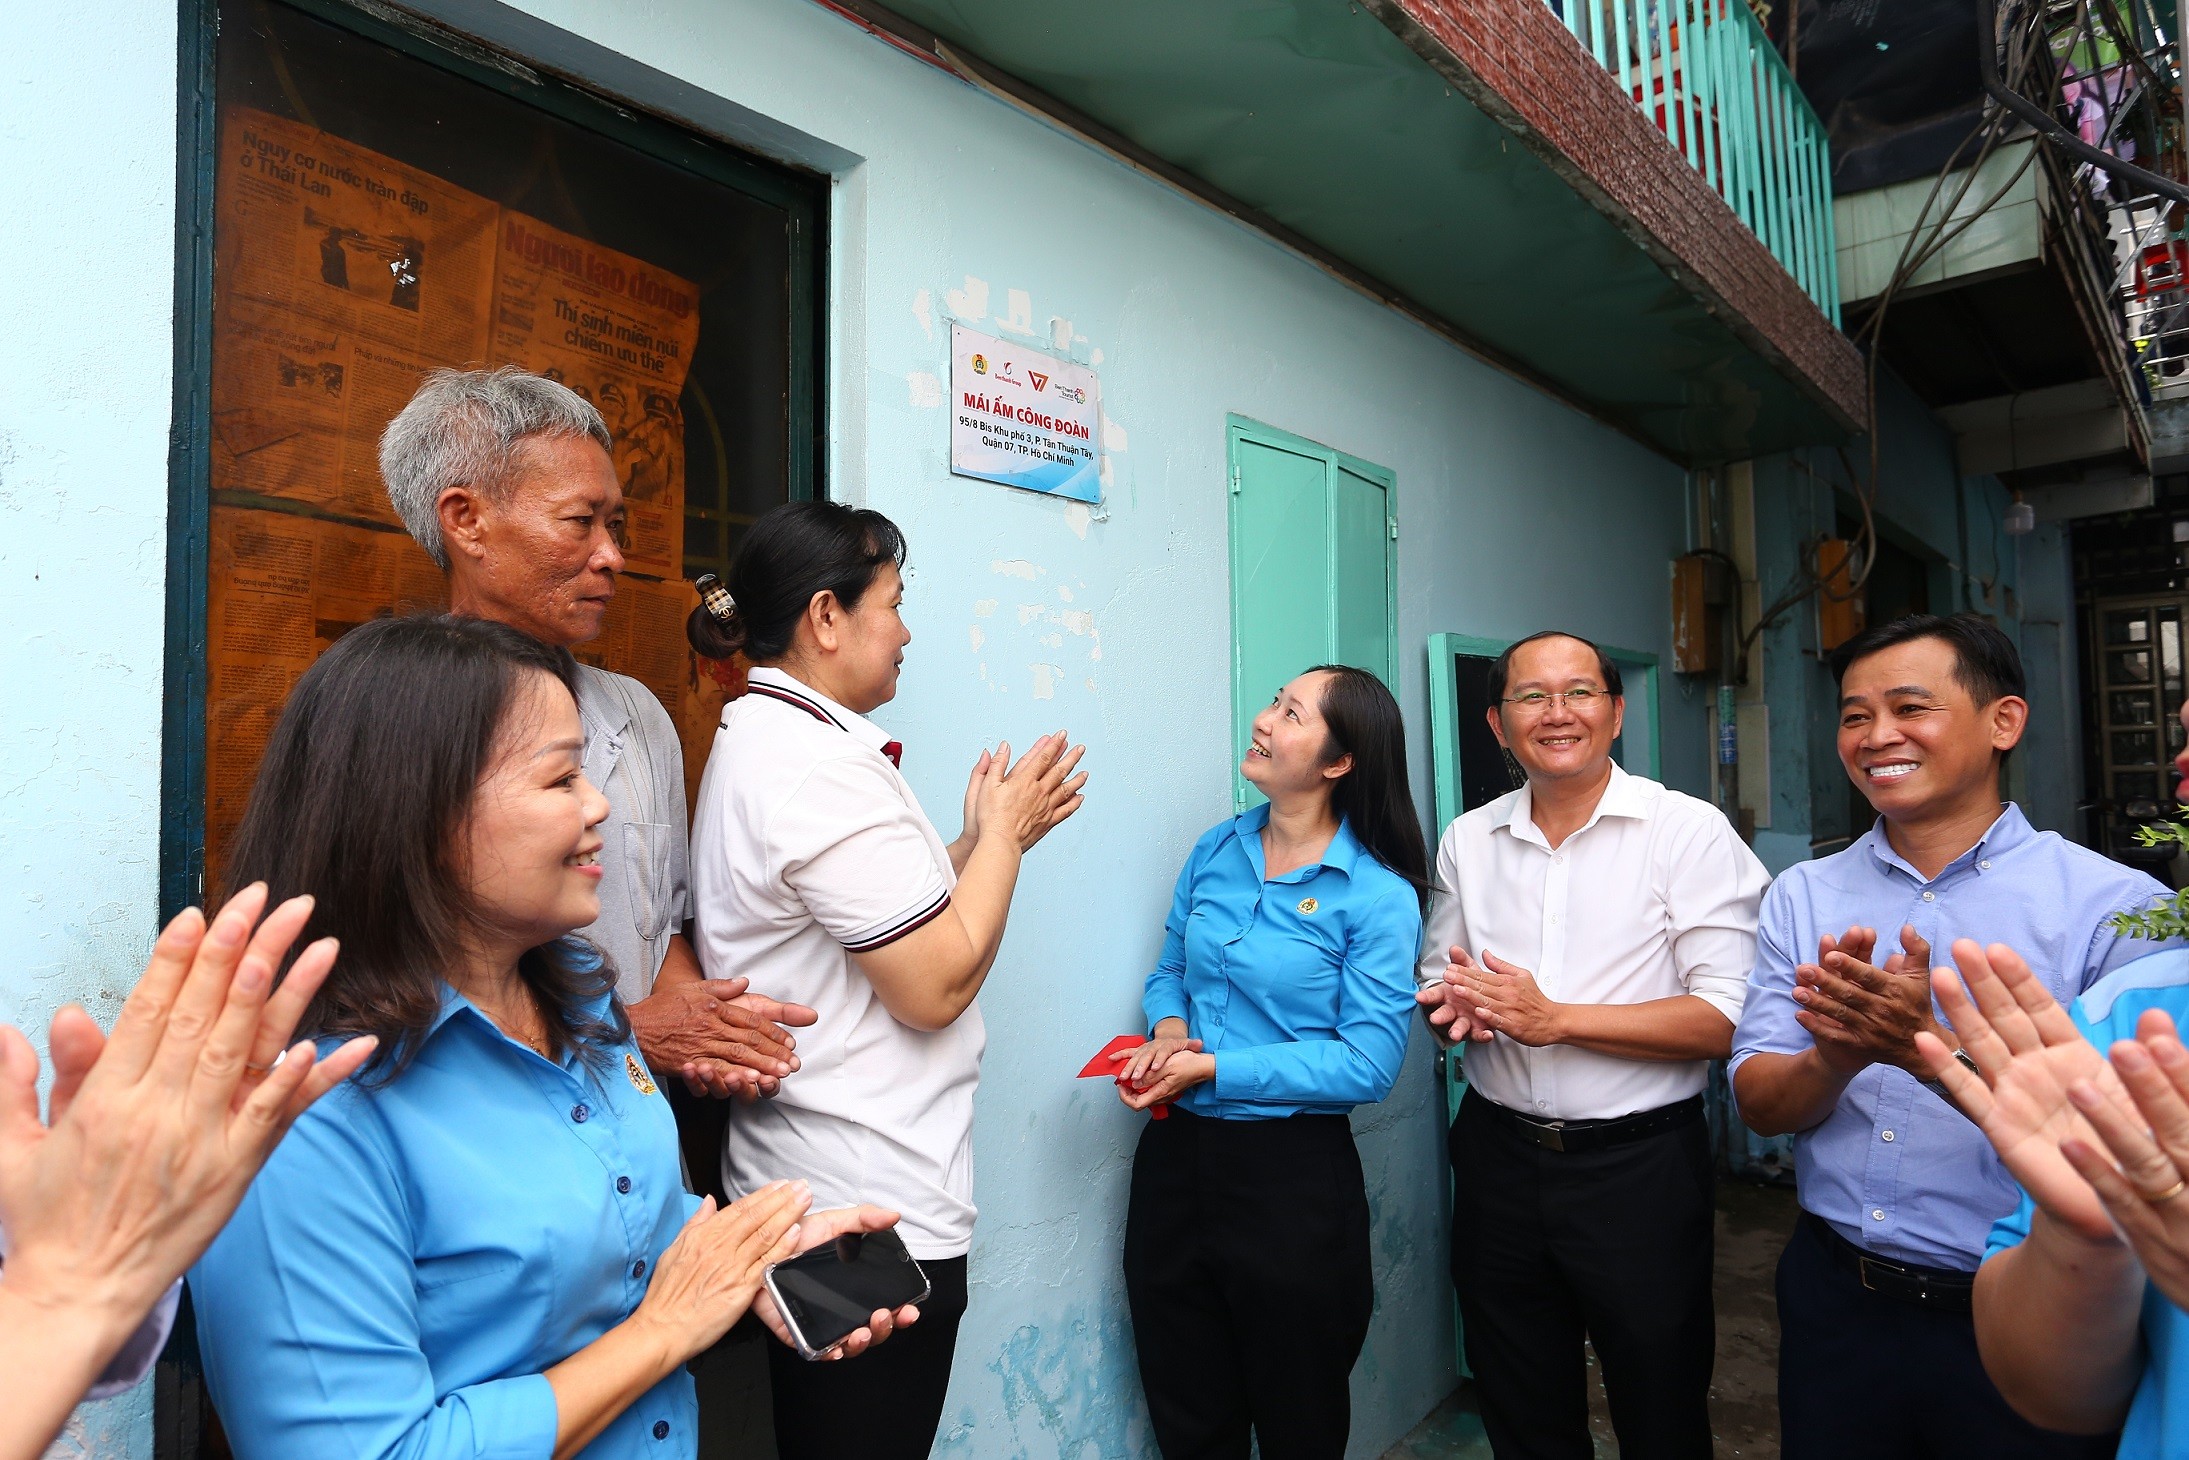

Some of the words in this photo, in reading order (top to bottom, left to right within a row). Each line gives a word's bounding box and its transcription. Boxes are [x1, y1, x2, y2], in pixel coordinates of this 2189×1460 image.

[242, 130, 291, 163] Nguy
[295, 152, 316, 170] cơ
[319, 161, 362, 188] nước
[365, 178, 397, 201] tràn
[400, 190, 428, 216] đập
[258, 156, 296, 185] Thái
[300, 172, 331, 198] Lan
[553, 298, 579, 323] Thí
[581, 310, 613, 337] sinh
[616, 324, 653, 351] miền
[656, 339, 680, 358] núi
[565, 327, 614, 357] chiếm
[617, 345, 638, 364] ưu
[641, 352, 665, 374] thế
[354, 347, 372, 361] Pháp
[374, 352, 383, 363] và
[959, 415, 978, 429] 95/8
[979, 419, 992, 433] Bis
[994, 423, 1009, 437] Khu
[1010, 426, 1026, 442] phố
[1026, 433, 1034, 446] 3,
[1035, 435, 1042, 446] P.
[1042, 437, 1056, 450] Tân
[1057, 441, 1080, 456] Thuận
[1080, 446, 1094, 461] Tây,
[963, 392, 990, 413] MÁI
[993, 395, 1014, 420] ẤM
[1016, 407, 1052, 430] CÔNG
[1054, 419, 1090, 440] ĐOÀN
[981, 435, 1003, 450] Quận
[1004, 439, 1016, 455] 07,
[1017, 444, 1029, 456] TP.
[1030, 447, 1042, 459] Hồ
[1042, 450, 1055, 462] Chí
[1056, 453, 1075, 467] Minh
